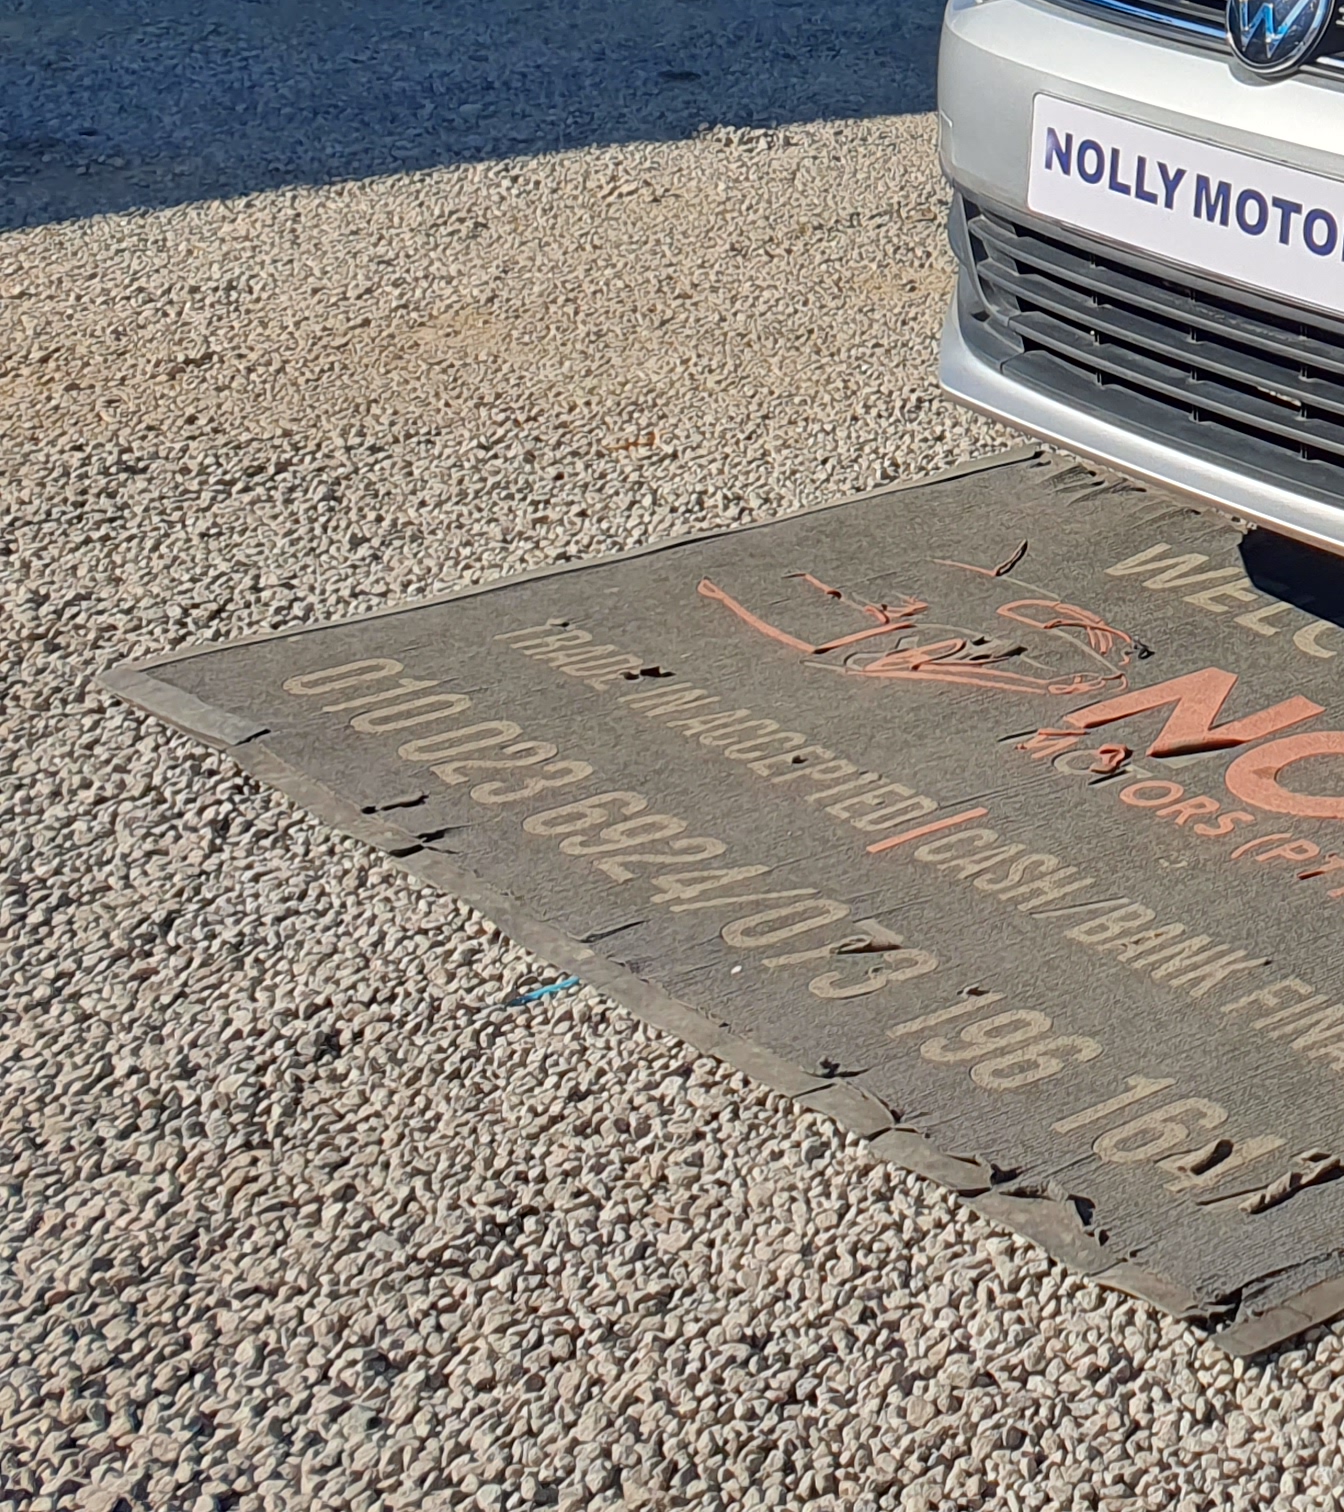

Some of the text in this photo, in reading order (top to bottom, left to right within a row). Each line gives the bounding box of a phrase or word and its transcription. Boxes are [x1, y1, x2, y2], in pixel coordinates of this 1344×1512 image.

[1043, 126, 1187, 211] NOLLY
[494, 618, 666, 691] TRADE
[616, 681, 725, 718] IN
[283, 656, 474, 736] 010
[398, 719, 595, 805] 023
[885, 990, 1102, 1091] 196
